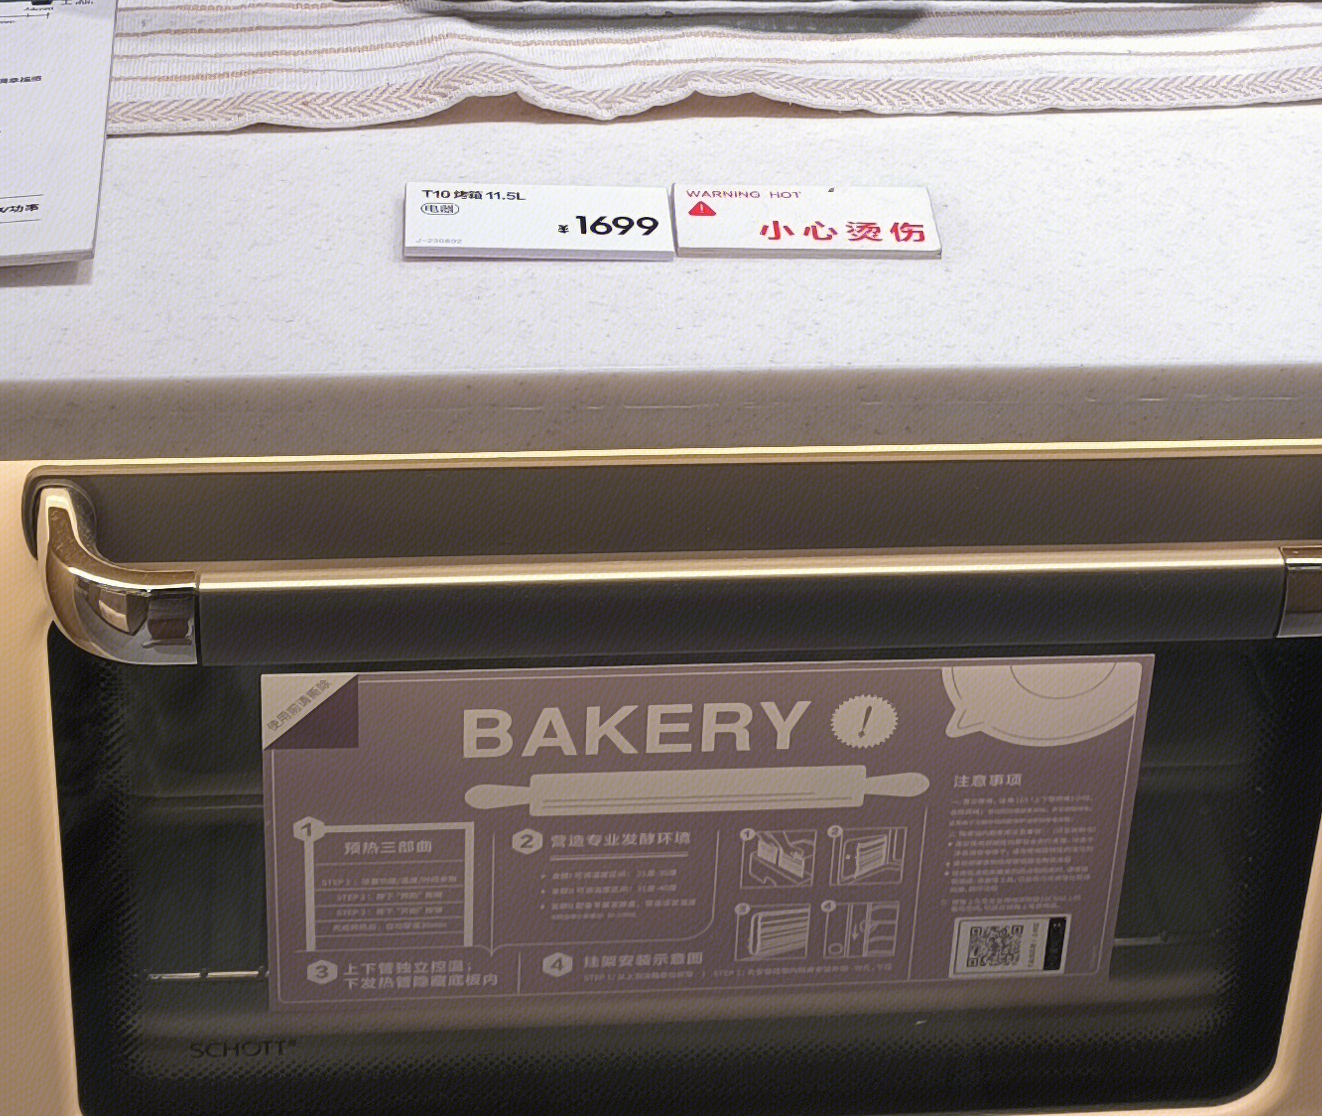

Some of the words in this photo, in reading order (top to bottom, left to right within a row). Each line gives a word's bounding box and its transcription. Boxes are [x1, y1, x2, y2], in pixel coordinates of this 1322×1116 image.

[421, 189, 451, 200] T10
[453, 189, 483, 201] 烤箱
[485, 191, 527, 202] 11.5L
[686, 188, 762, 200] WARNING
[769, 189, 802, 200] HOT
[424, 203, 455, 215] 电器
[759, 219, 926, 243] 小心烫伤
[462, 700, 813, 759] BAKERY
[300, 821, 314, 838] 1
[343, 838, 433, 856] 预热三部曲
[518, 833, 536, 850] 2
[550, 830, 692, 849] 营造专业发酵环境
[313, 964, 330, 979] 3
[549, 956, 565, 972] 4
